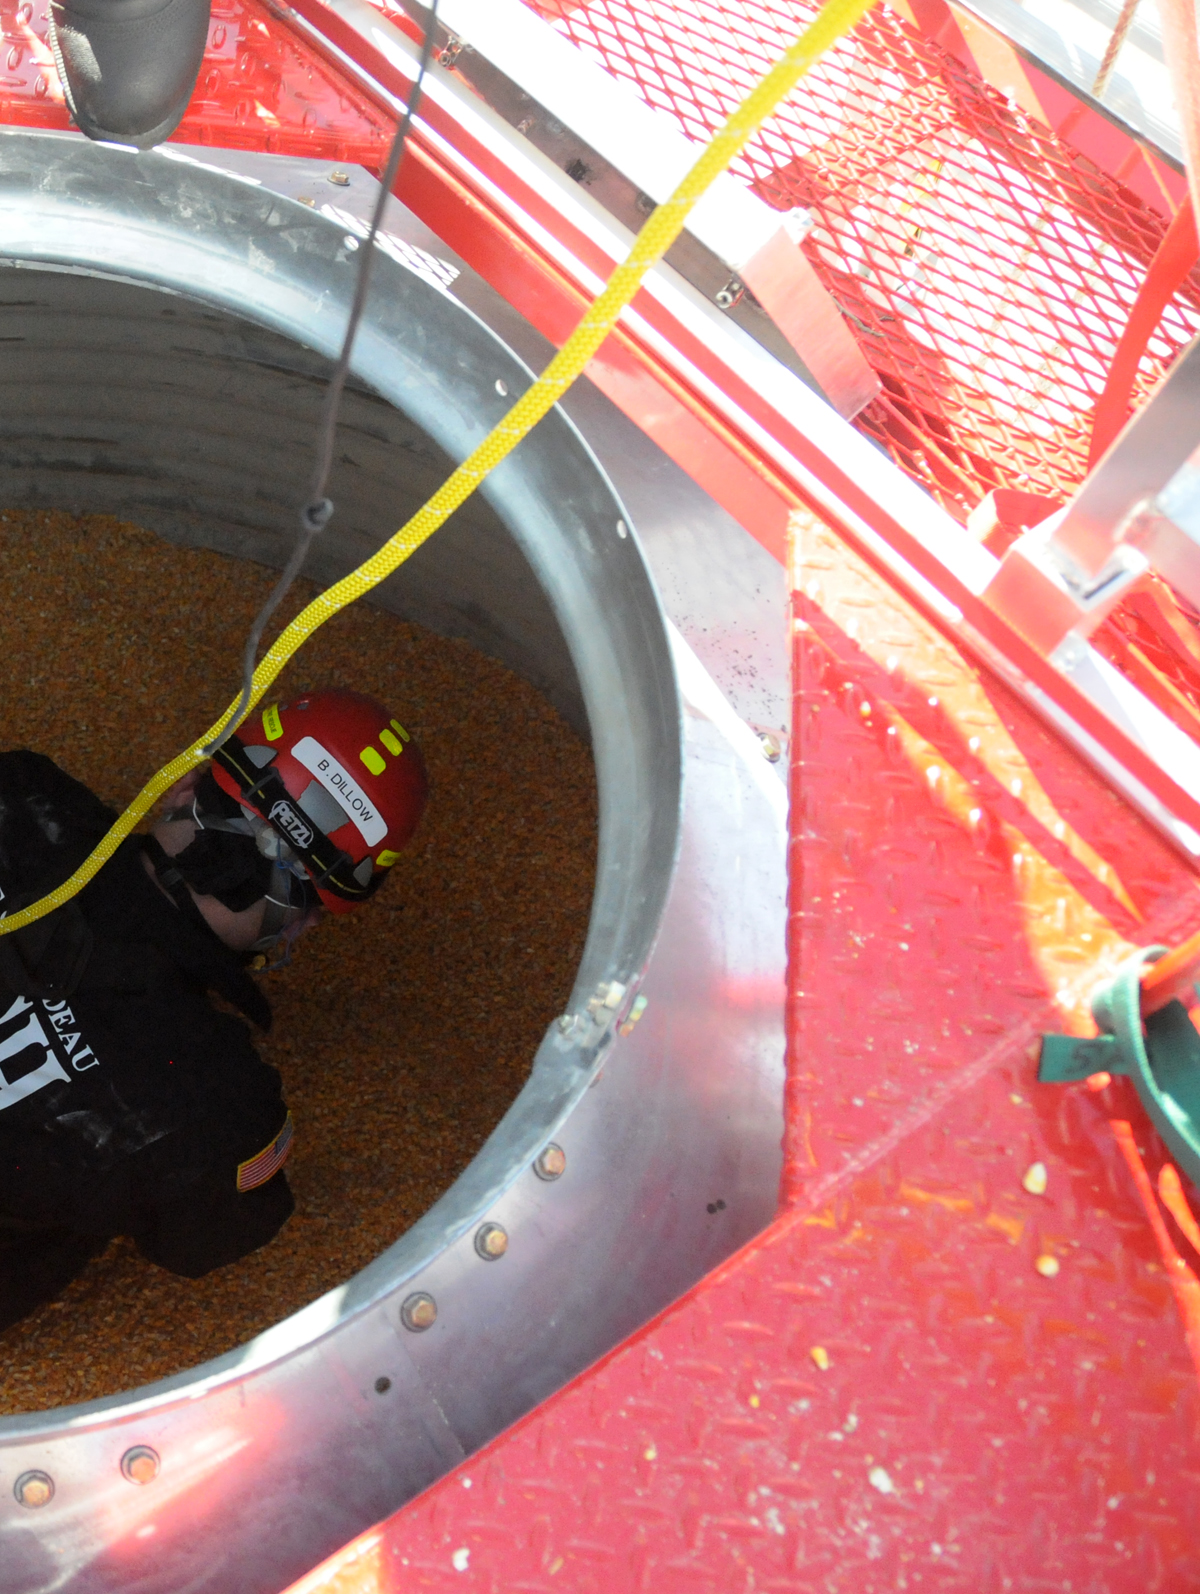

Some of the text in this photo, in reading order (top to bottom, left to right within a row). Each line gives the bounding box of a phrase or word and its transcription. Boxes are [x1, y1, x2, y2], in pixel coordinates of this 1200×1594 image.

[317, 759, 373, 822] B. DILLOW
[268, 802, 308, 849] PETZL
